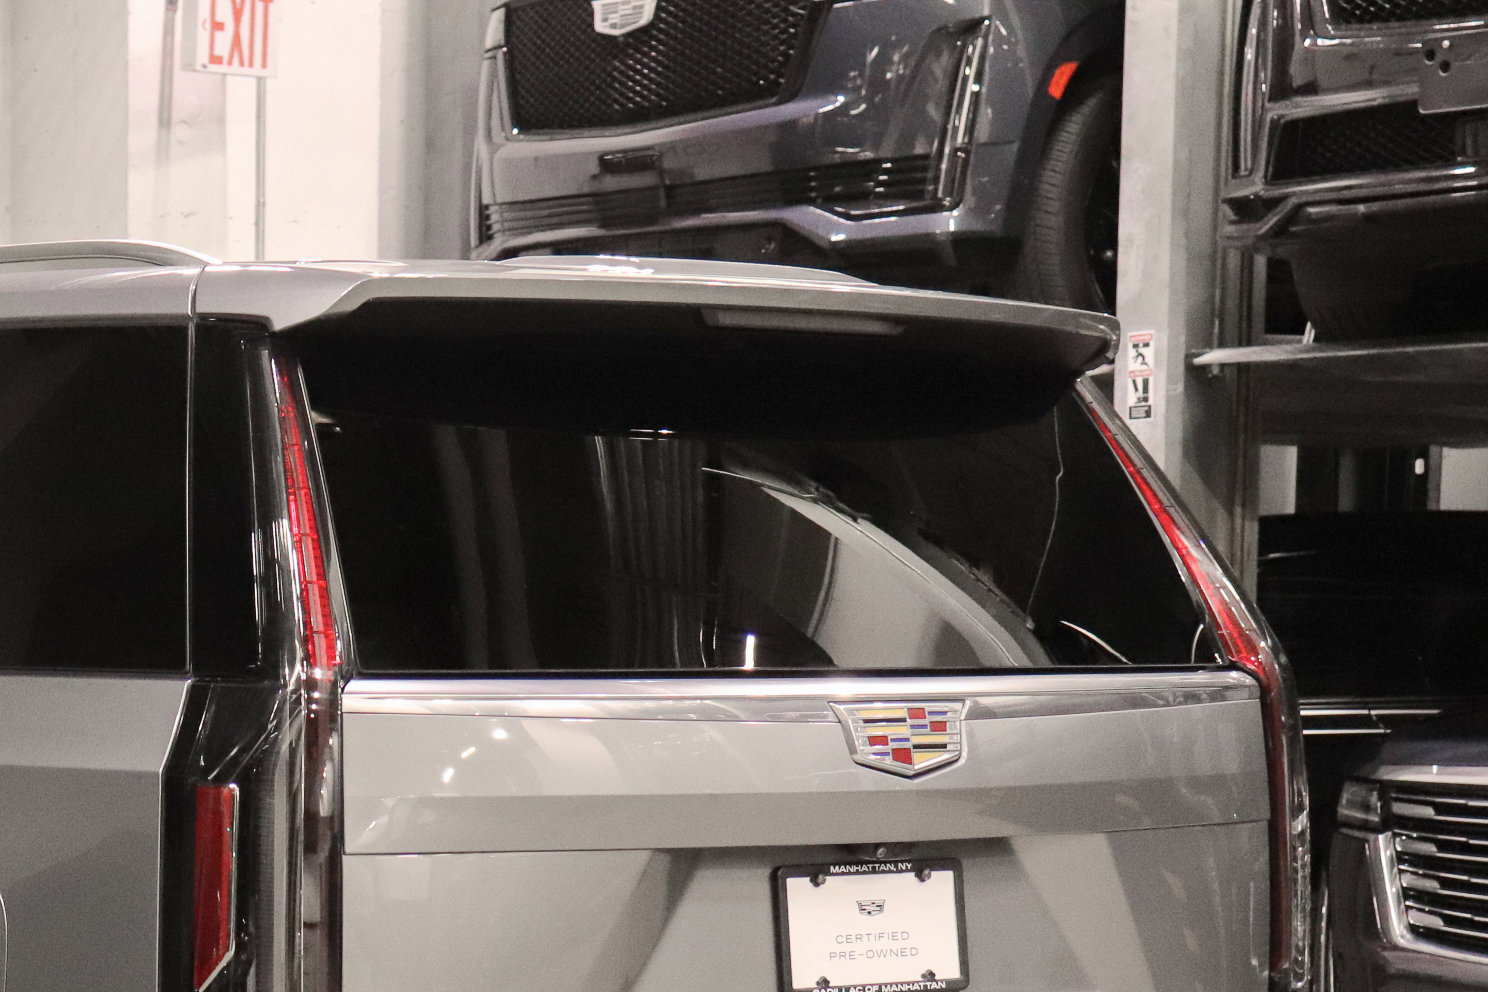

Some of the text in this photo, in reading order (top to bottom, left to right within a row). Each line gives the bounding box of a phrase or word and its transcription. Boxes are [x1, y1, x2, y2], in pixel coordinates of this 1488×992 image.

[208, 0, 273, 69] EXIT
[830, 862, 912, 873] MANHATTAN, NY
[835, 931, 910, 944] CERTIFIED
[829, 947, 919, 960] PRE-OWNED
[881, 981, 946, 992] MANHATTAN
